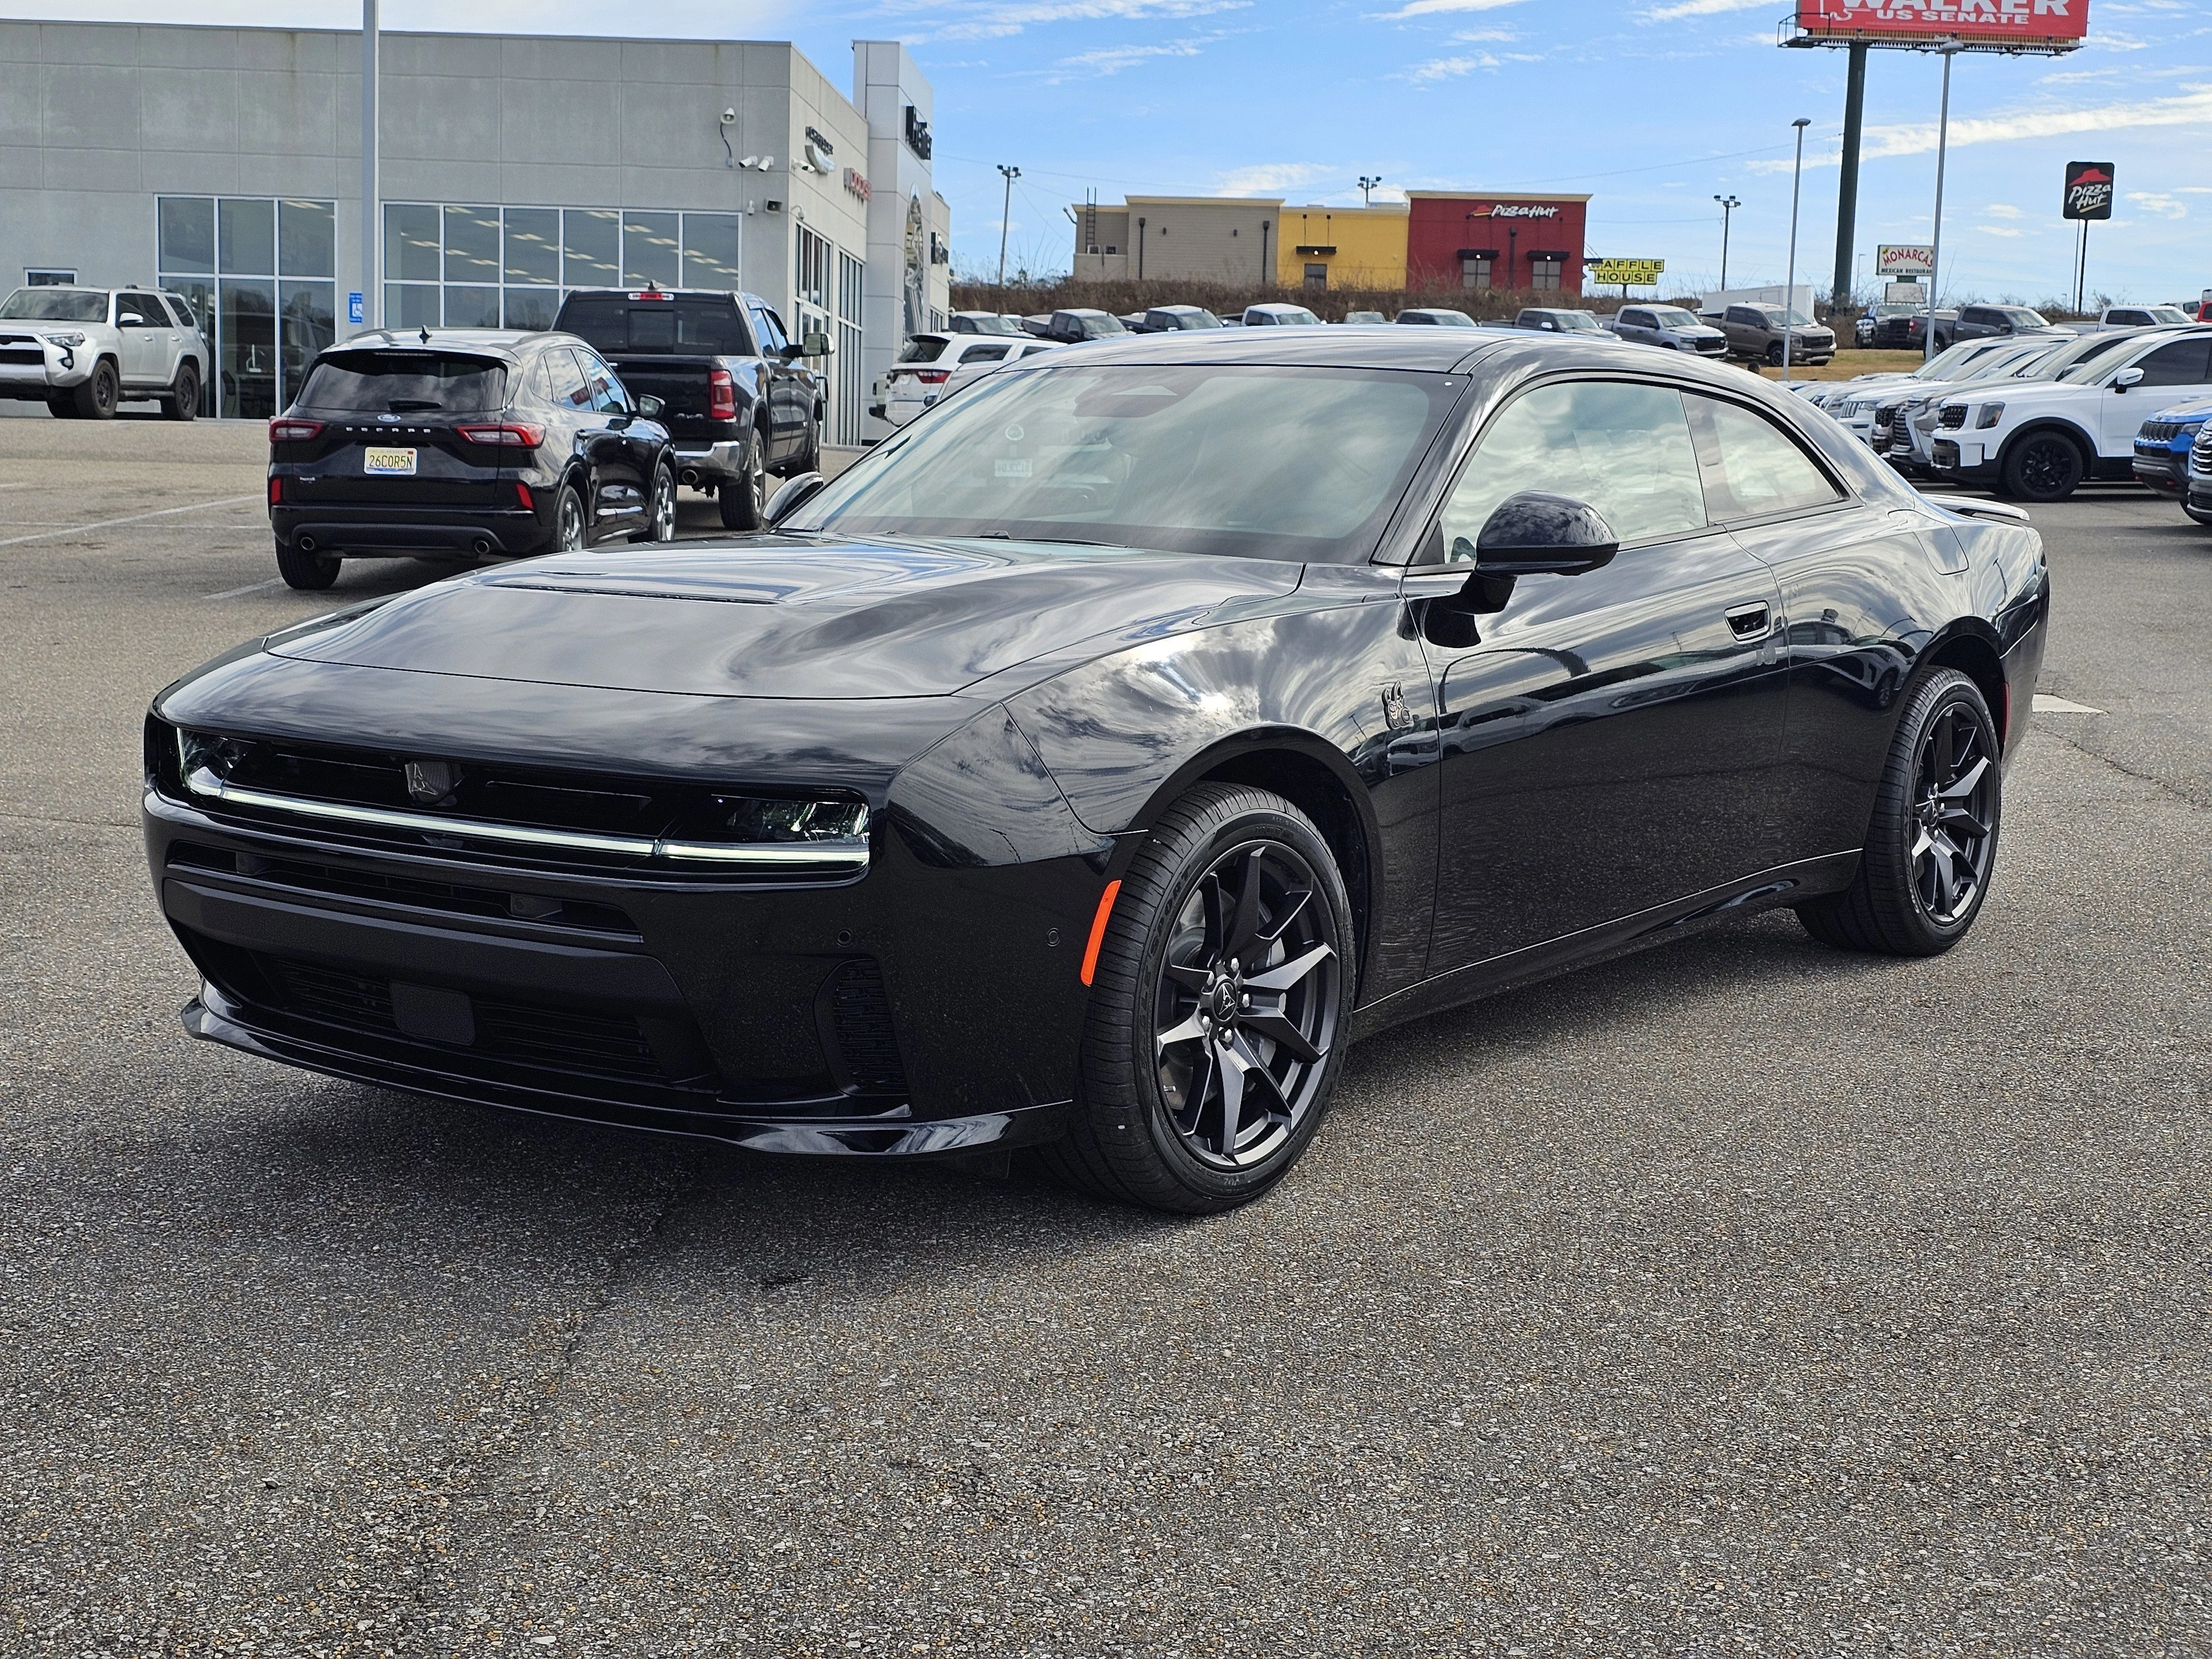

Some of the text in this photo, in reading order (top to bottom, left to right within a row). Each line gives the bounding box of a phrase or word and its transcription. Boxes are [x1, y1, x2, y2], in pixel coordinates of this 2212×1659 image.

[1876, 9, 2029, 24] US SENATE
[2068, 182, 2111, 204] Pizza
[2075, 194, 2107, 210] Hut
[1592, 260, 1662, 269] AFFLE
[1597, 273, 1655, 282] HOUSE
